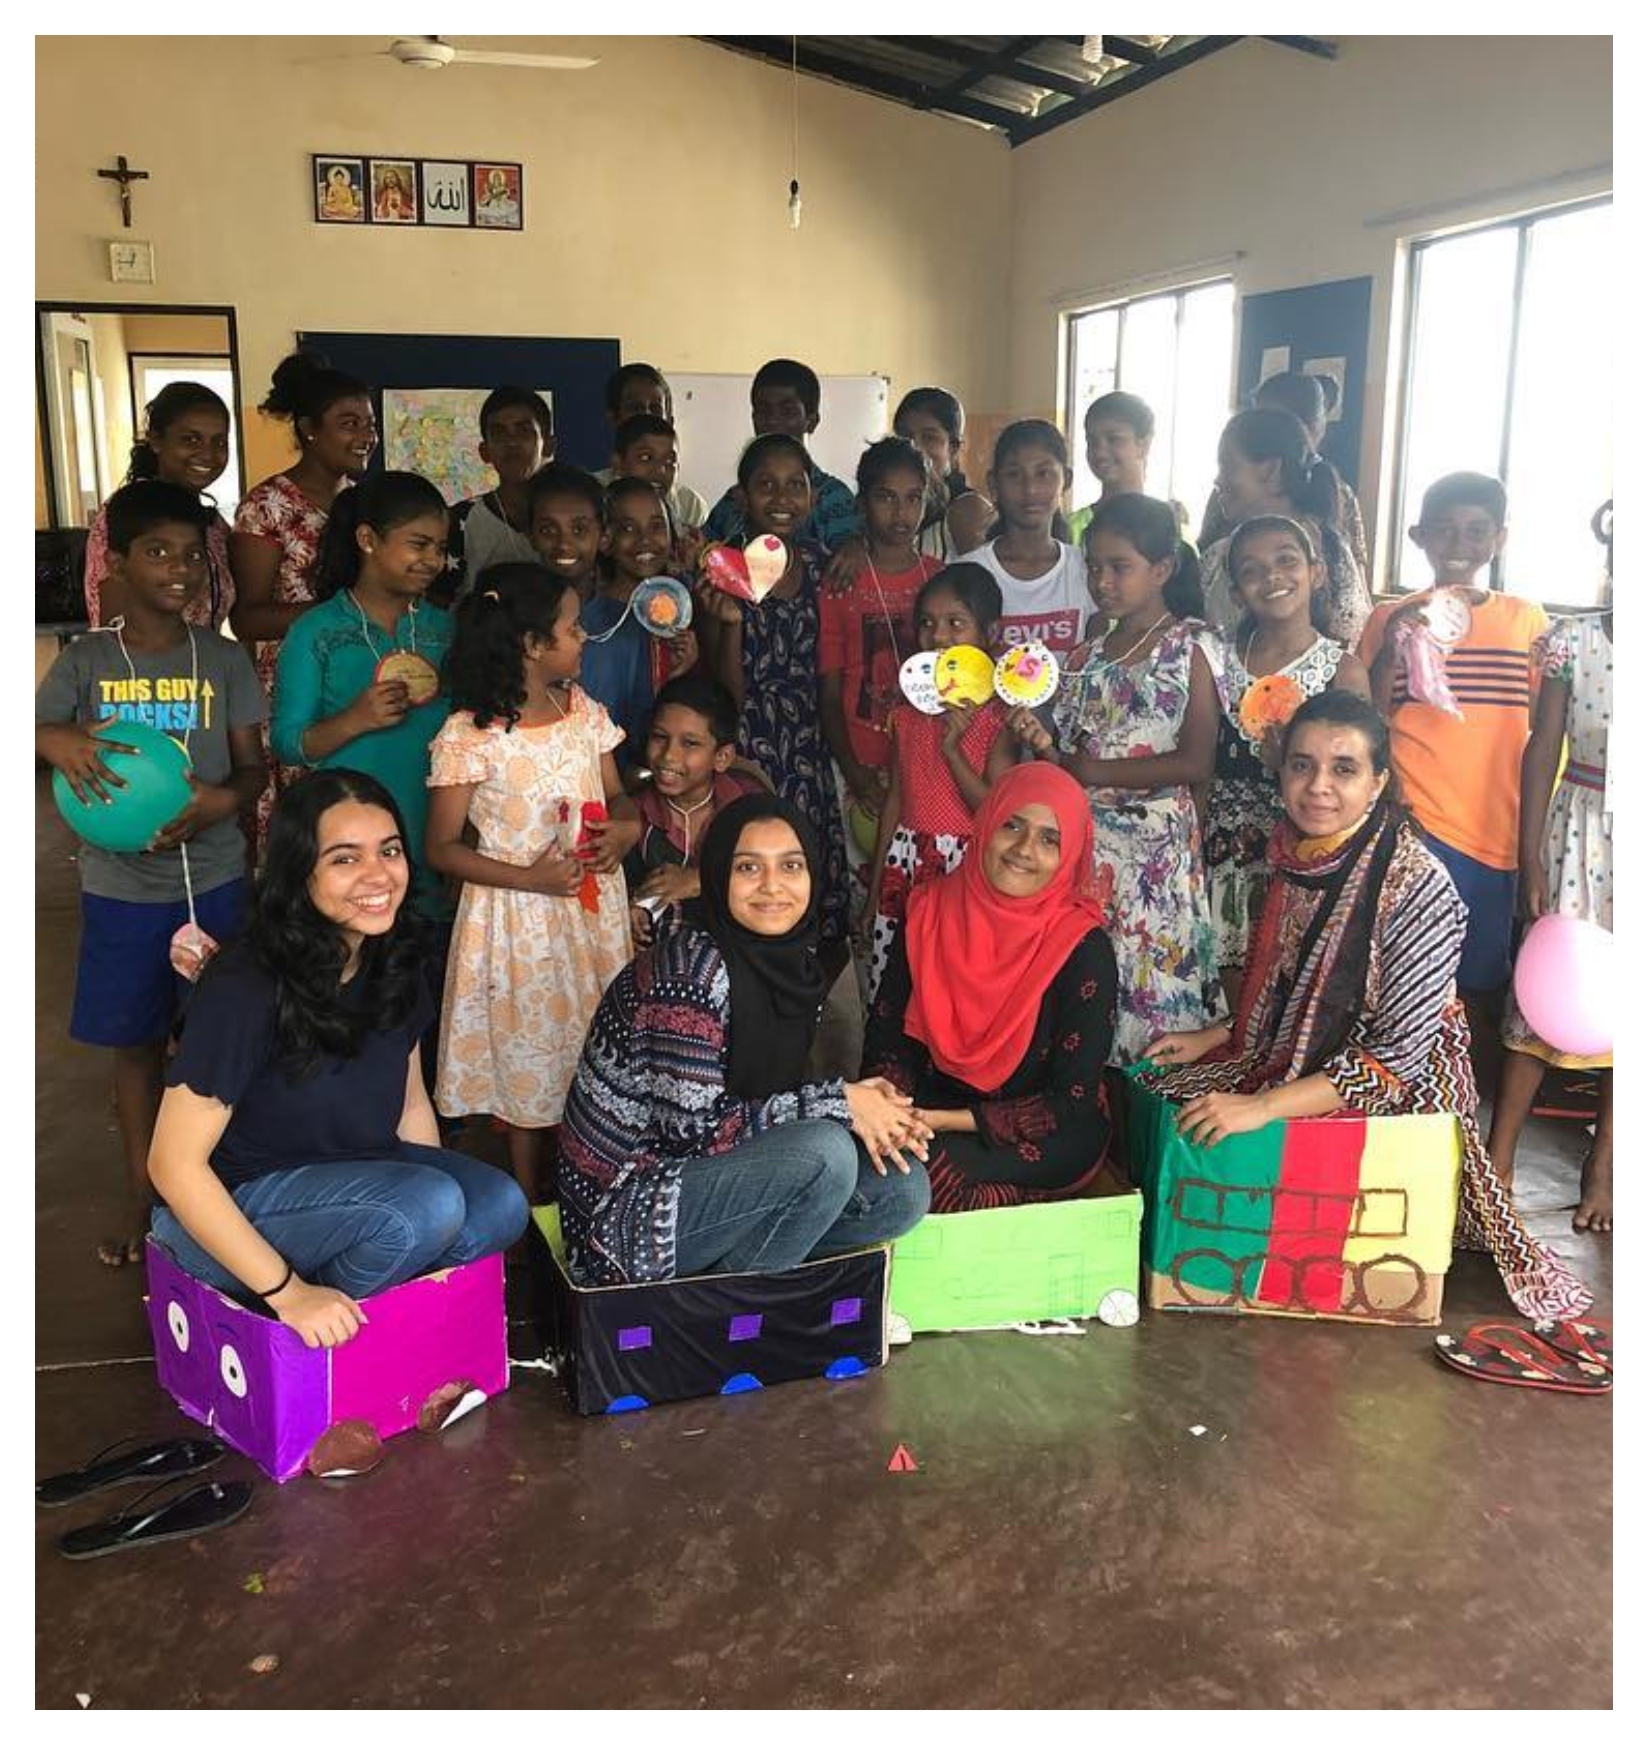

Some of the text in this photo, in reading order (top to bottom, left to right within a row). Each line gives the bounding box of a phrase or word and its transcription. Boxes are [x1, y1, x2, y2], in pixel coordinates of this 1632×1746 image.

[427, 177, 466, 211] الله
[1003, 619, 1072, 645] evi's
[99, 677, 198, 702] THIS GUY
